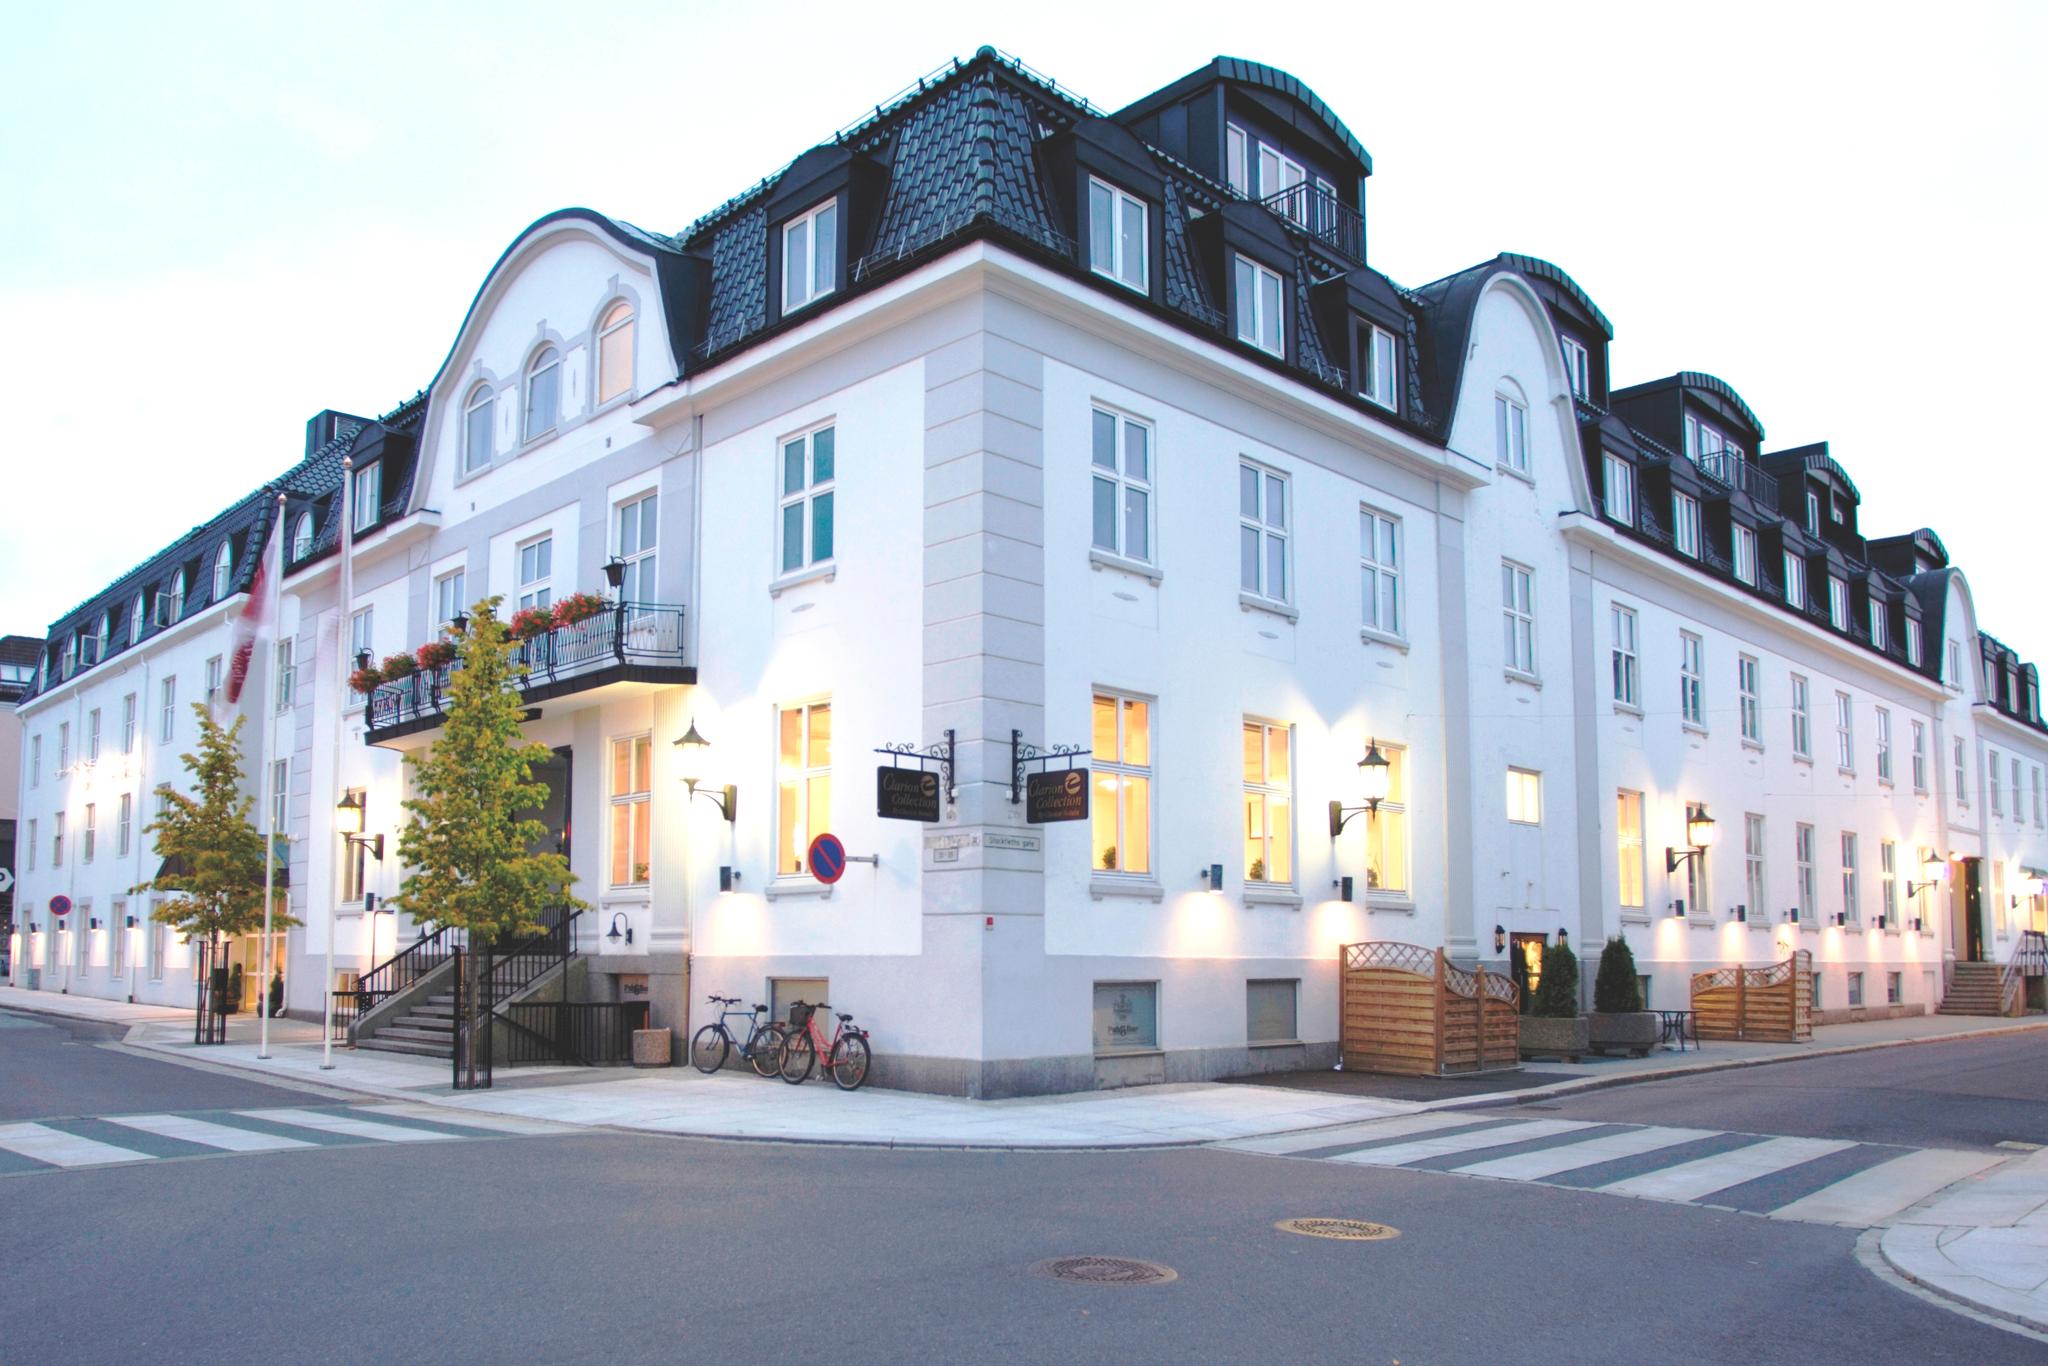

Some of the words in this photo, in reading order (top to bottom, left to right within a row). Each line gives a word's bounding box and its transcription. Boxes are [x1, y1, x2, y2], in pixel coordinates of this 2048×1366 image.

[883, 773, 919, 792] Clarion
[1029, 778, 1064, 797] Clarion
[891, 792, 937, 808] Collection
[1036, 795, 1082, 809] Collection
